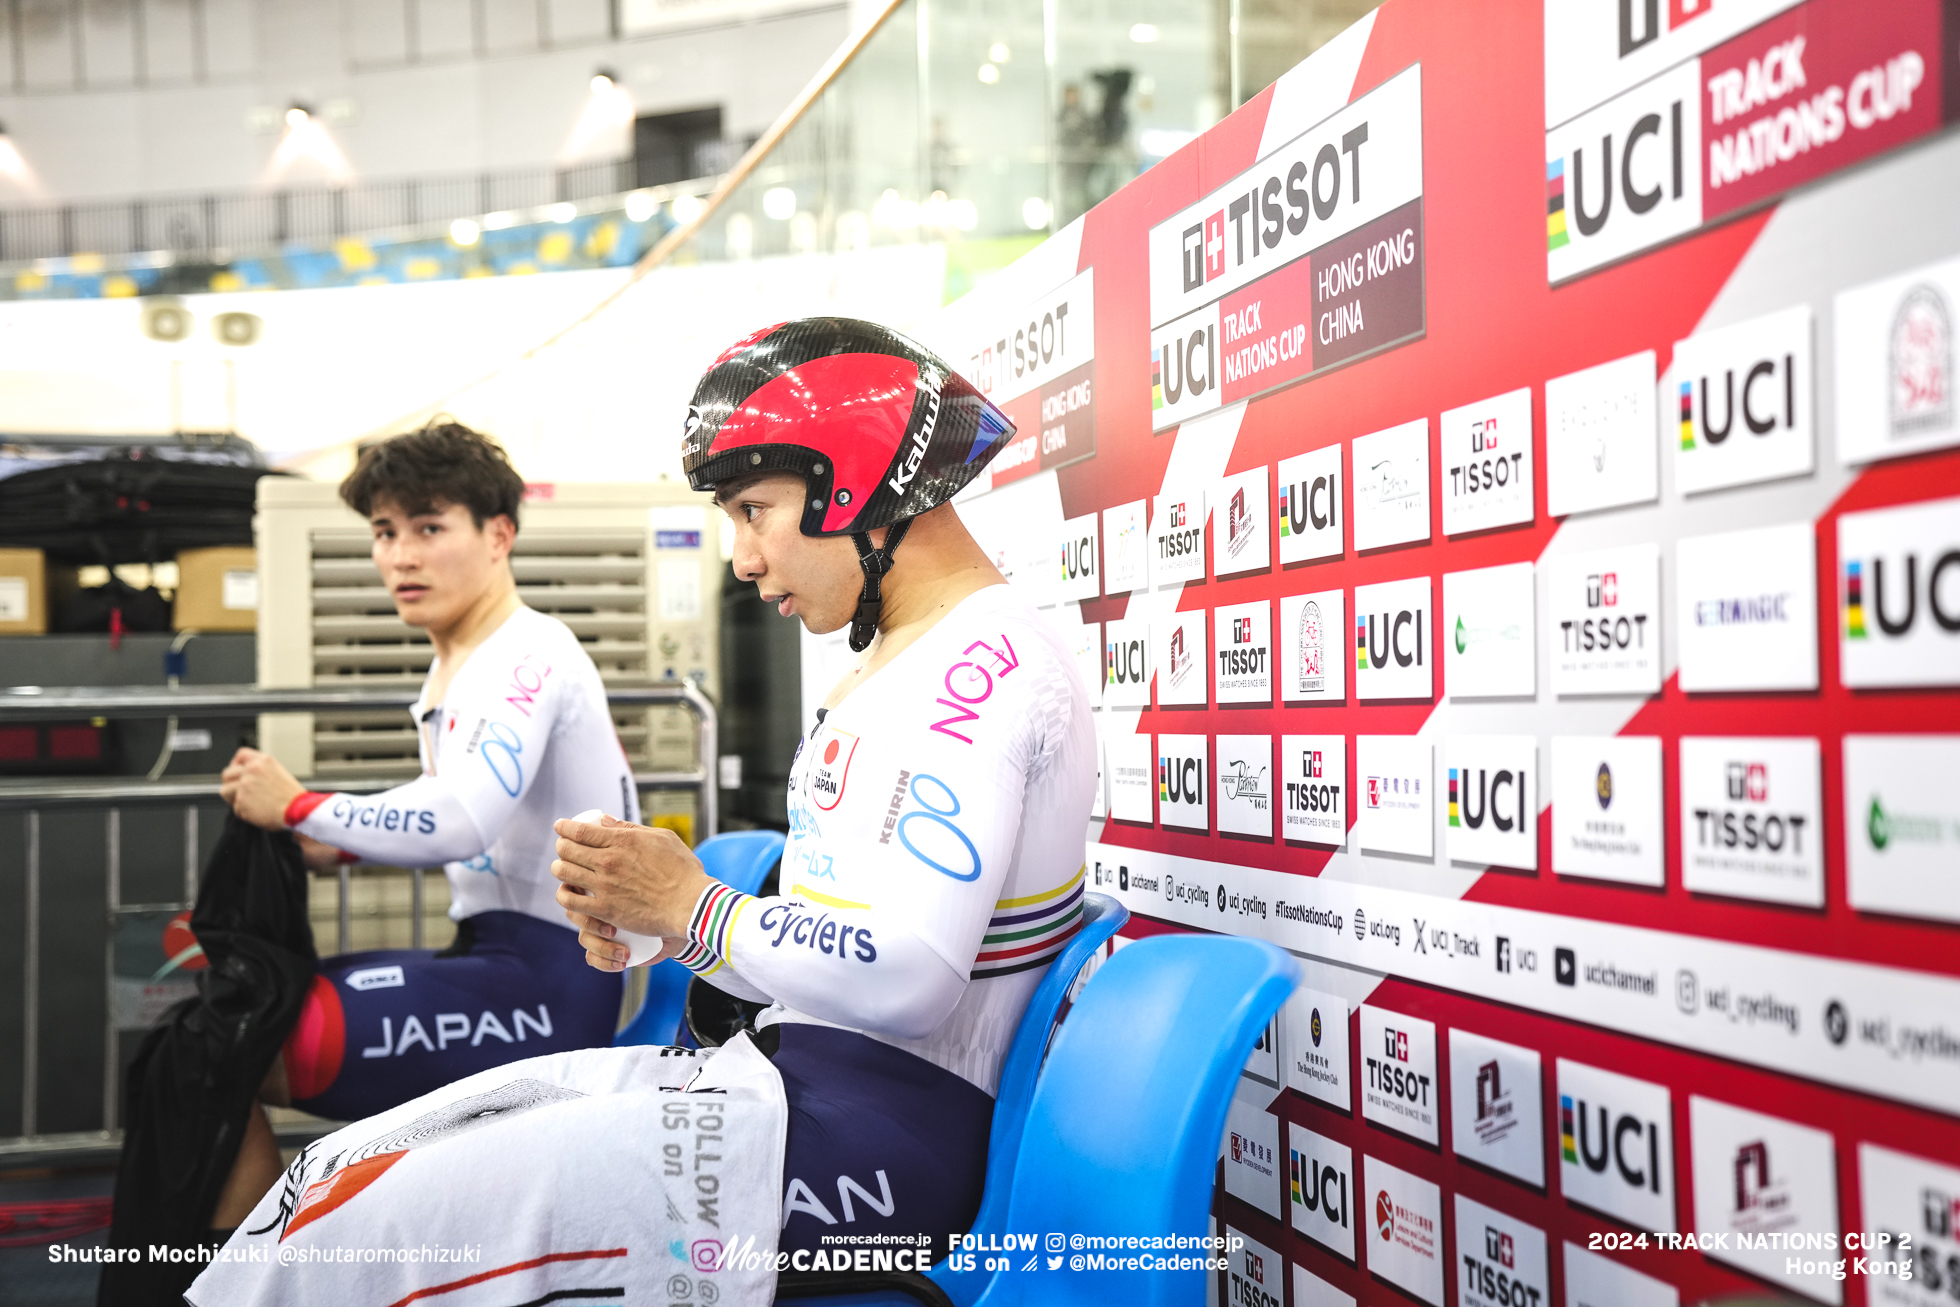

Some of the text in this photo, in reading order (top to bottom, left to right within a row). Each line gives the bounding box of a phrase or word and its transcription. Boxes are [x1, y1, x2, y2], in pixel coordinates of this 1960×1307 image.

[1707, 35, 1806, 124] TRACK
[1709, 50, 1925, 189] NATIONS CUP
[1572, 98, 1683, 238] UCI
[1228, 120, 1369, 267] TISSOT
[1318, 228, 1415, 303] HONG KONG
[996, 301, 1068, 387] TISSOT
[1223, 300, 1263, 345] TRACK
[1319, 299, 1364, 346] CHINA
[1162, 323, 1215, 405] UCI
[1225, 323, 1306, 384] NATIONS CUP
[1041, 379, 1091, 424] HONG KONG
[1700, 352, 1795, 446] UCI
[1042, 424, 1067, 455] CHINA
[1450, 452, 1523, 497] TISSOT
[1289, 473, 1336, 535] UCI
[1067, 535, 1095, 580] UCI
[1158, 528, 1201, 560] TISSOT
[1873, 548, 1960, 639] UC
[1369, 608, 1423, 670] UCI
[1560, 614, 1648, 653] TISSOT
[1114, 639, 1145, 684] UCI
[1219, 647, 1267, 676] TISSOT
[813, 776, 837, 795] JAPAN
[819, 768, 832, 779] TEAM
[1167, 757, 1203, 805] UCI
[1286, 782, 1340, 814] TISSOT
[879, 769, 911, 845] KEIRIN
[1462, 768, 1526, 834] UCI
[1694, 808, 1808, 857] TISSOT
[1131, 873, 1159, 893] ucichannel
[1175, 881, 1210, 908] uci_cycling
[1229, 892, 1268, 920] uci_cycling
[1275, 900, 1344, 936] #TissotNationsCup
[1369, 917, 1401, 947] uci.org
[1431, 928, 1481, 958] UCI_Track
[1584, 960, 1658, 997] ucichannel
[361, 1003, 554, 1059] JAPAN
[1704, 986, 1800, 1036] uci_cycling
[1366, 1057, 1430, 1107] TISSOT
[661, 1101, 690, 1177] US on
[1578, 1099, 1661, 1197] UCI
[694, 1101, 725, 1230] FOLLOW
[1300, 1152, 1348, 1229] UCI
